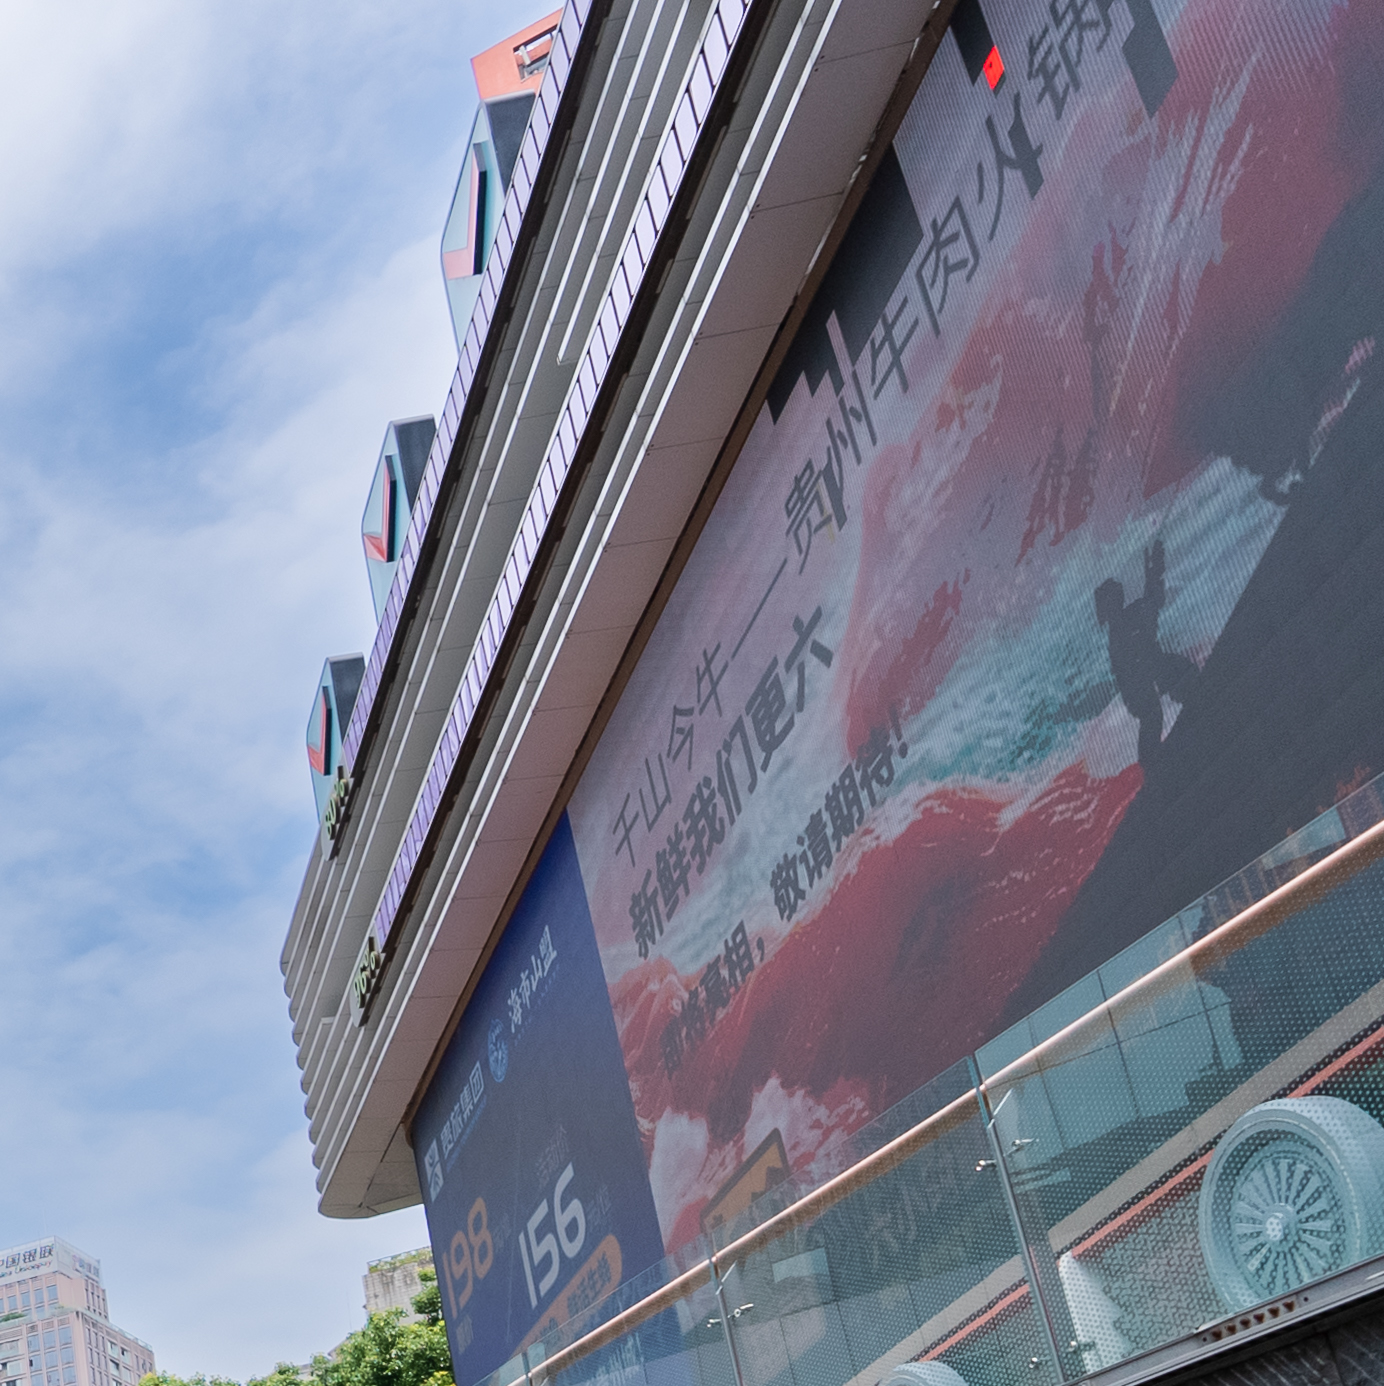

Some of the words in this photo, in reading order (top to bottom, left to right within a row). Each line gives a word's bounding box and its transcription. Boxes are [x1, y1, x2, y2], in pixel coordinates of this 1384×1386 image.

[629, 605, 834, 960] 新鲜我们更六
[508, 924, 557, 1033] 海市山盟
[440, 1061, 485, 1160] 贵旅集团
[442, 1197, 494, 1320] 198
[518, 1161, 586, 1310] 156
